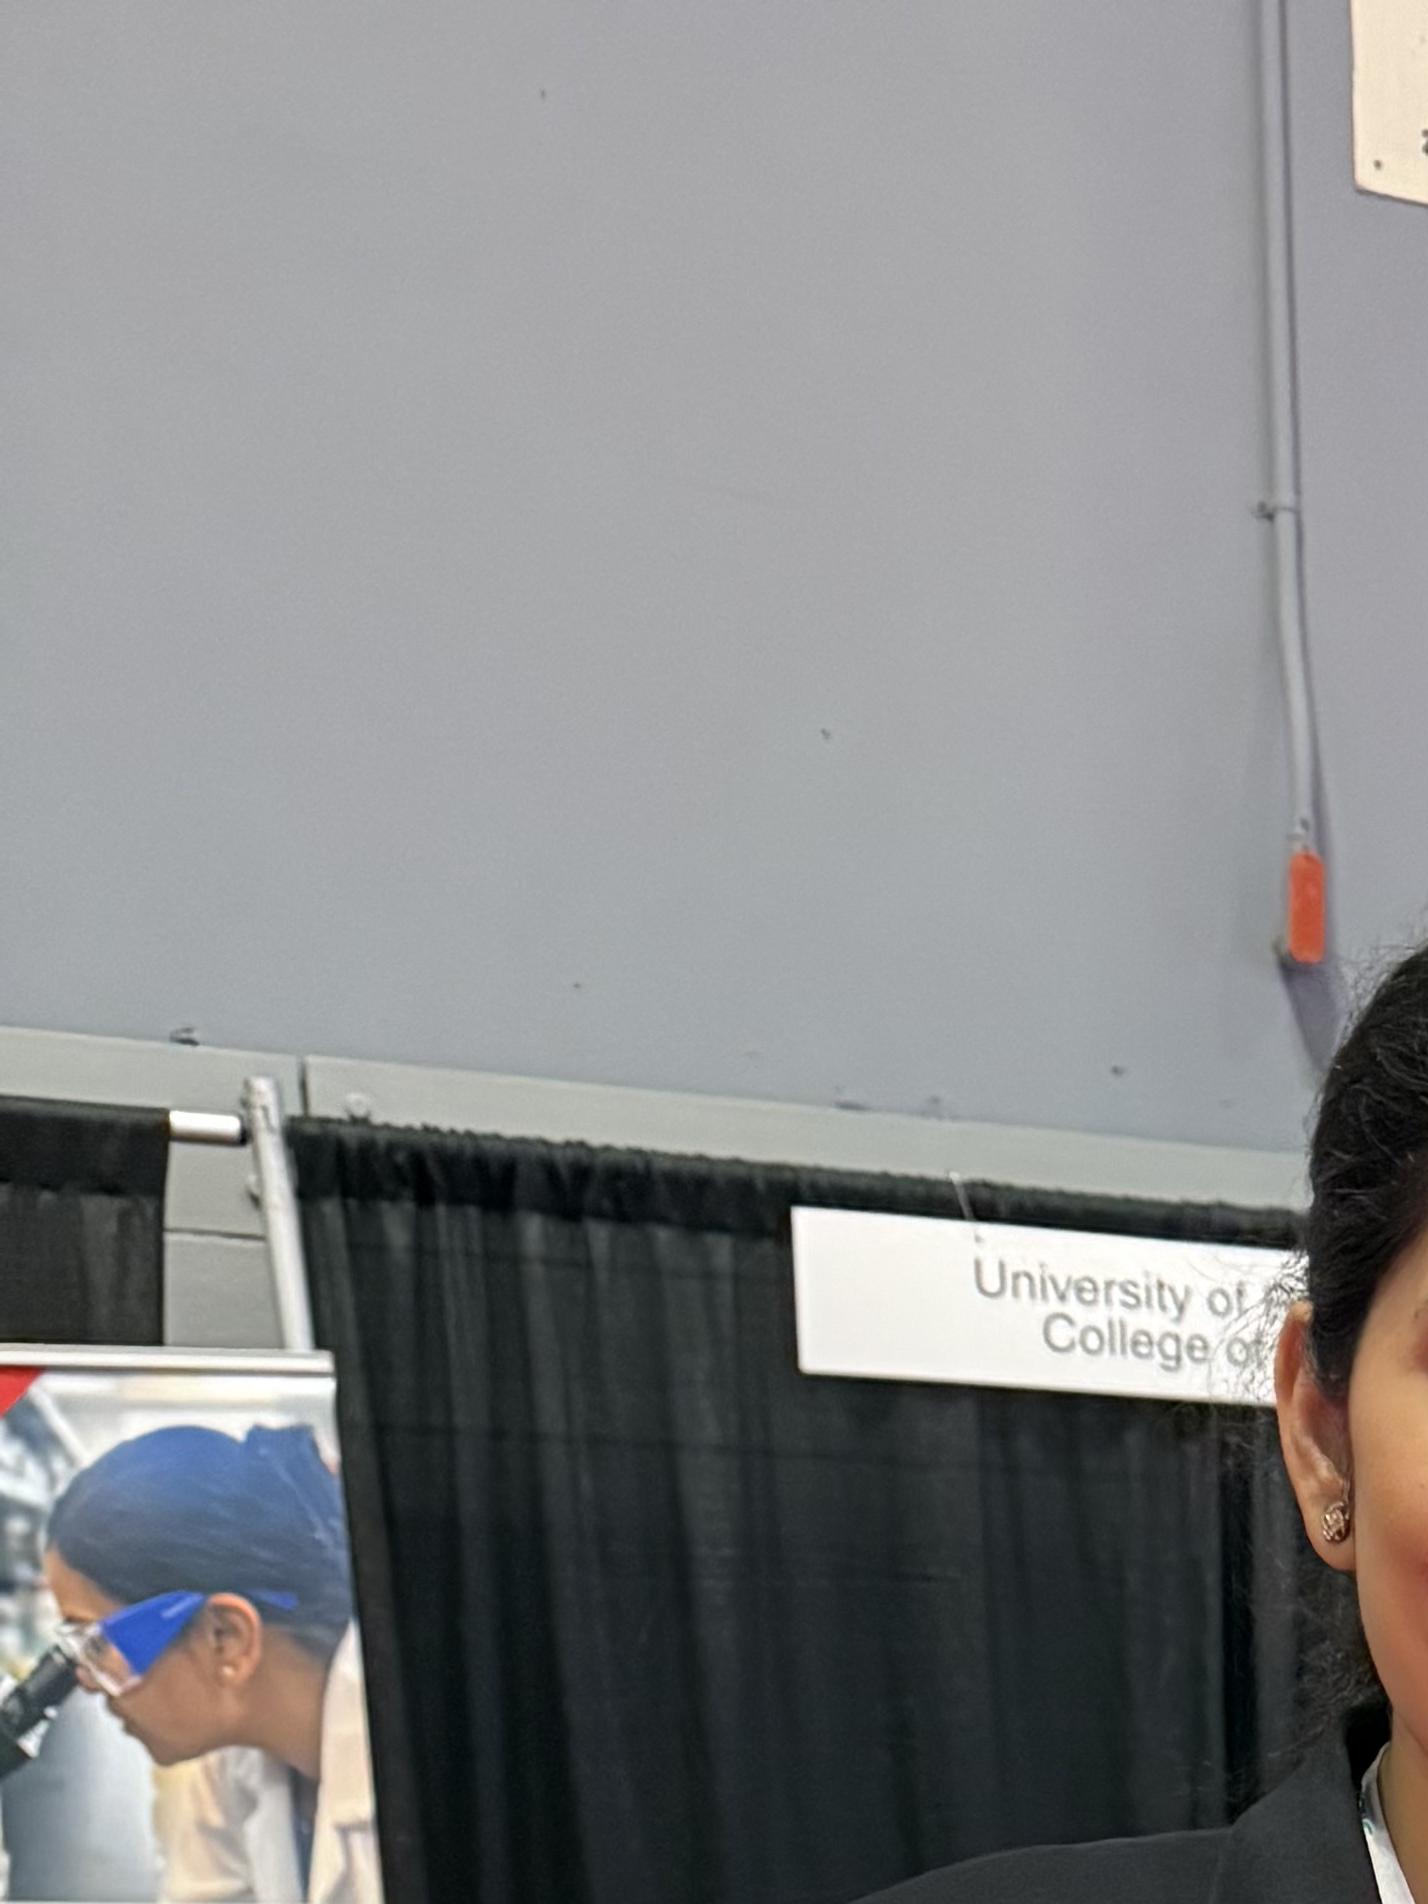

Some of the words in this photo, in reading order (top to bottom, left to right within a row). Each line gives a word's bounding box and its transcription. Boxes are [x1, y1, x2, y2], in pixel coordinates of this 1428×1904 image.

[974, 1257, 1193, 1324] University
[1207, 1279, 1247, 1319] of
[1043, 1312, 1209, 1373] College
